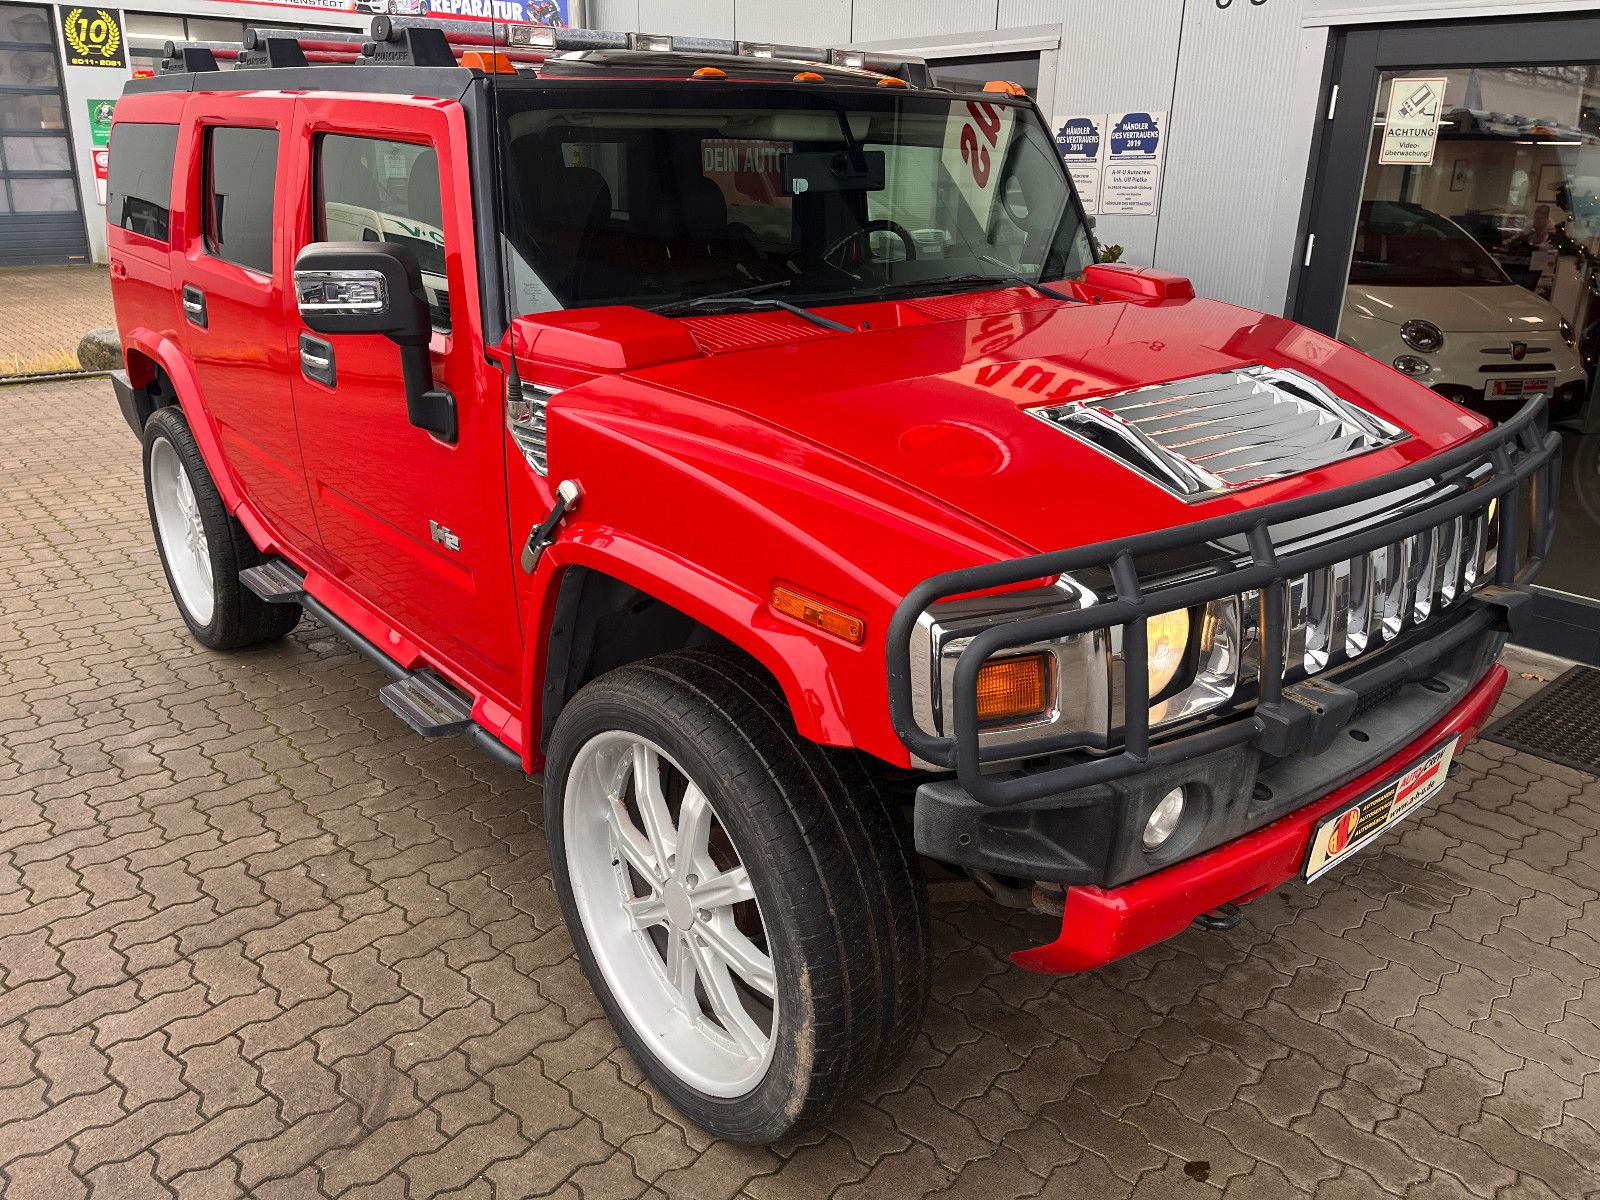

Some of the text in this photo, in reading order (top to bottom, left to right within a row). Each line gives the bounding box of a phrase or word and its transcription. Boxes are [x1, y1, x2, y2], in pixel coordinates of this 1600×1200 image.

[429, 0, 524, 21] REPARATUR
[77, 18, 108, 43] 10
[1066, 126, 1090, 135] HÄNDLER
[1123, 122, 1148, 131] HÄNDLER
[1123, 131, 1158, 139] VERTRAUENS
[1388, 128, 1434, 136] ACHTUNG
[1057, 135, 1099, 144] DES VERTRAUENS
[704, 147, 739, 172] DEIN
